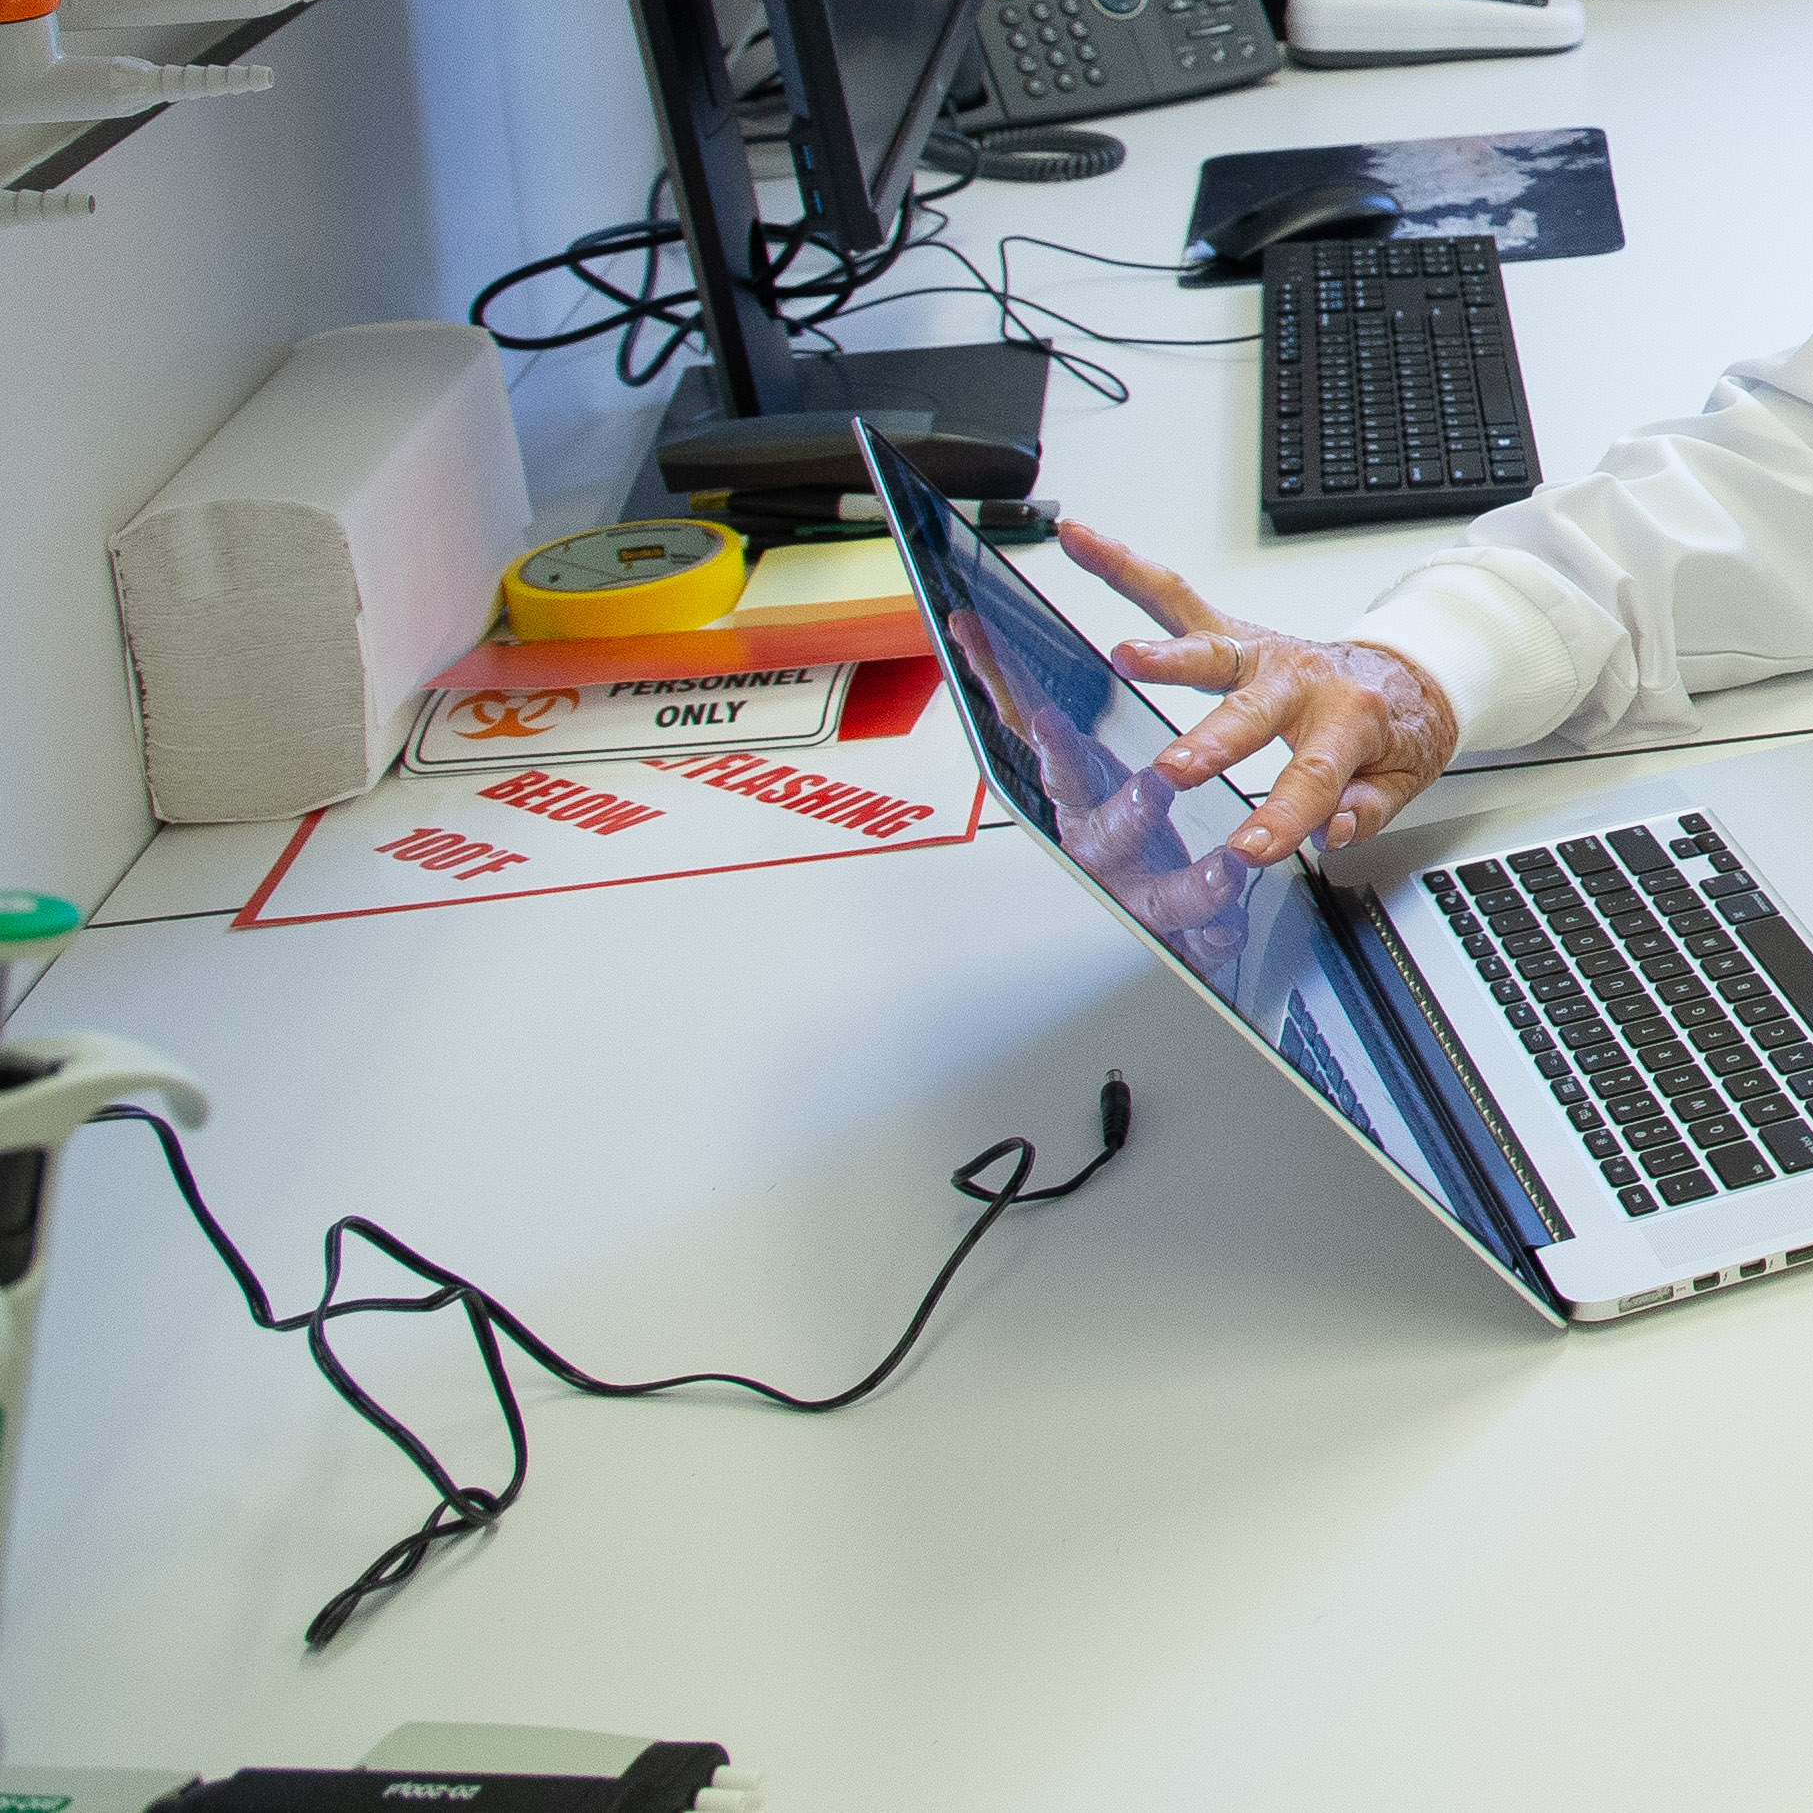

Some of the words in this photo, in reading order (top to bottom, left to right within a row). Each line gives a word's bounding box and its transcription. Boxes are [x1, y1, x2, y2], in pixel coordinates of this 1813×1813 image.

[655, 700, 748, 728] ONLY
[475, 768, 667, 837] BELOW
[1629, 919, 1643, 927] L
[1529, 936, 1543, 944] 0
[1579, 937, 1594, 945] O
[1643, 940, 1658, 948] K
[1702, 938, 1718, 947] M
[1719, 960, 1734, 969] N
[1557, 980, 1571, 988] 8
[1609, 980, 1625, 989] U
[1675, 984, 1689, 993] H
[1736, 983, 1751, 991] B
[1625, 1004, 1640, 1012] Y
[1691, 1007, 1706, 1016] G
[1752, 1006, 1767, 1014] V
[1641, 1027, 1656, 1035] T
[1770, 1028, 1785, 1037] C
[1603, 1050, 1618, 1058] 5
[1657, 1050, 1672, 1059] R
[1725, 1054, 1741, 1063] D
[1789, 1052, 1804, 1061] X
[1674, 1075, 1690, 1083] E
[1743, 1079, 1758, 1088] S
[1636, 1100, 1650, 1108] 3
[1690, 1099, 1707, 1110] W
[1762, 1104, 1777, 1112] A
[1653, 1125, 1668, 1134] 2
[1709, 1124, 1725, 1134] Q
